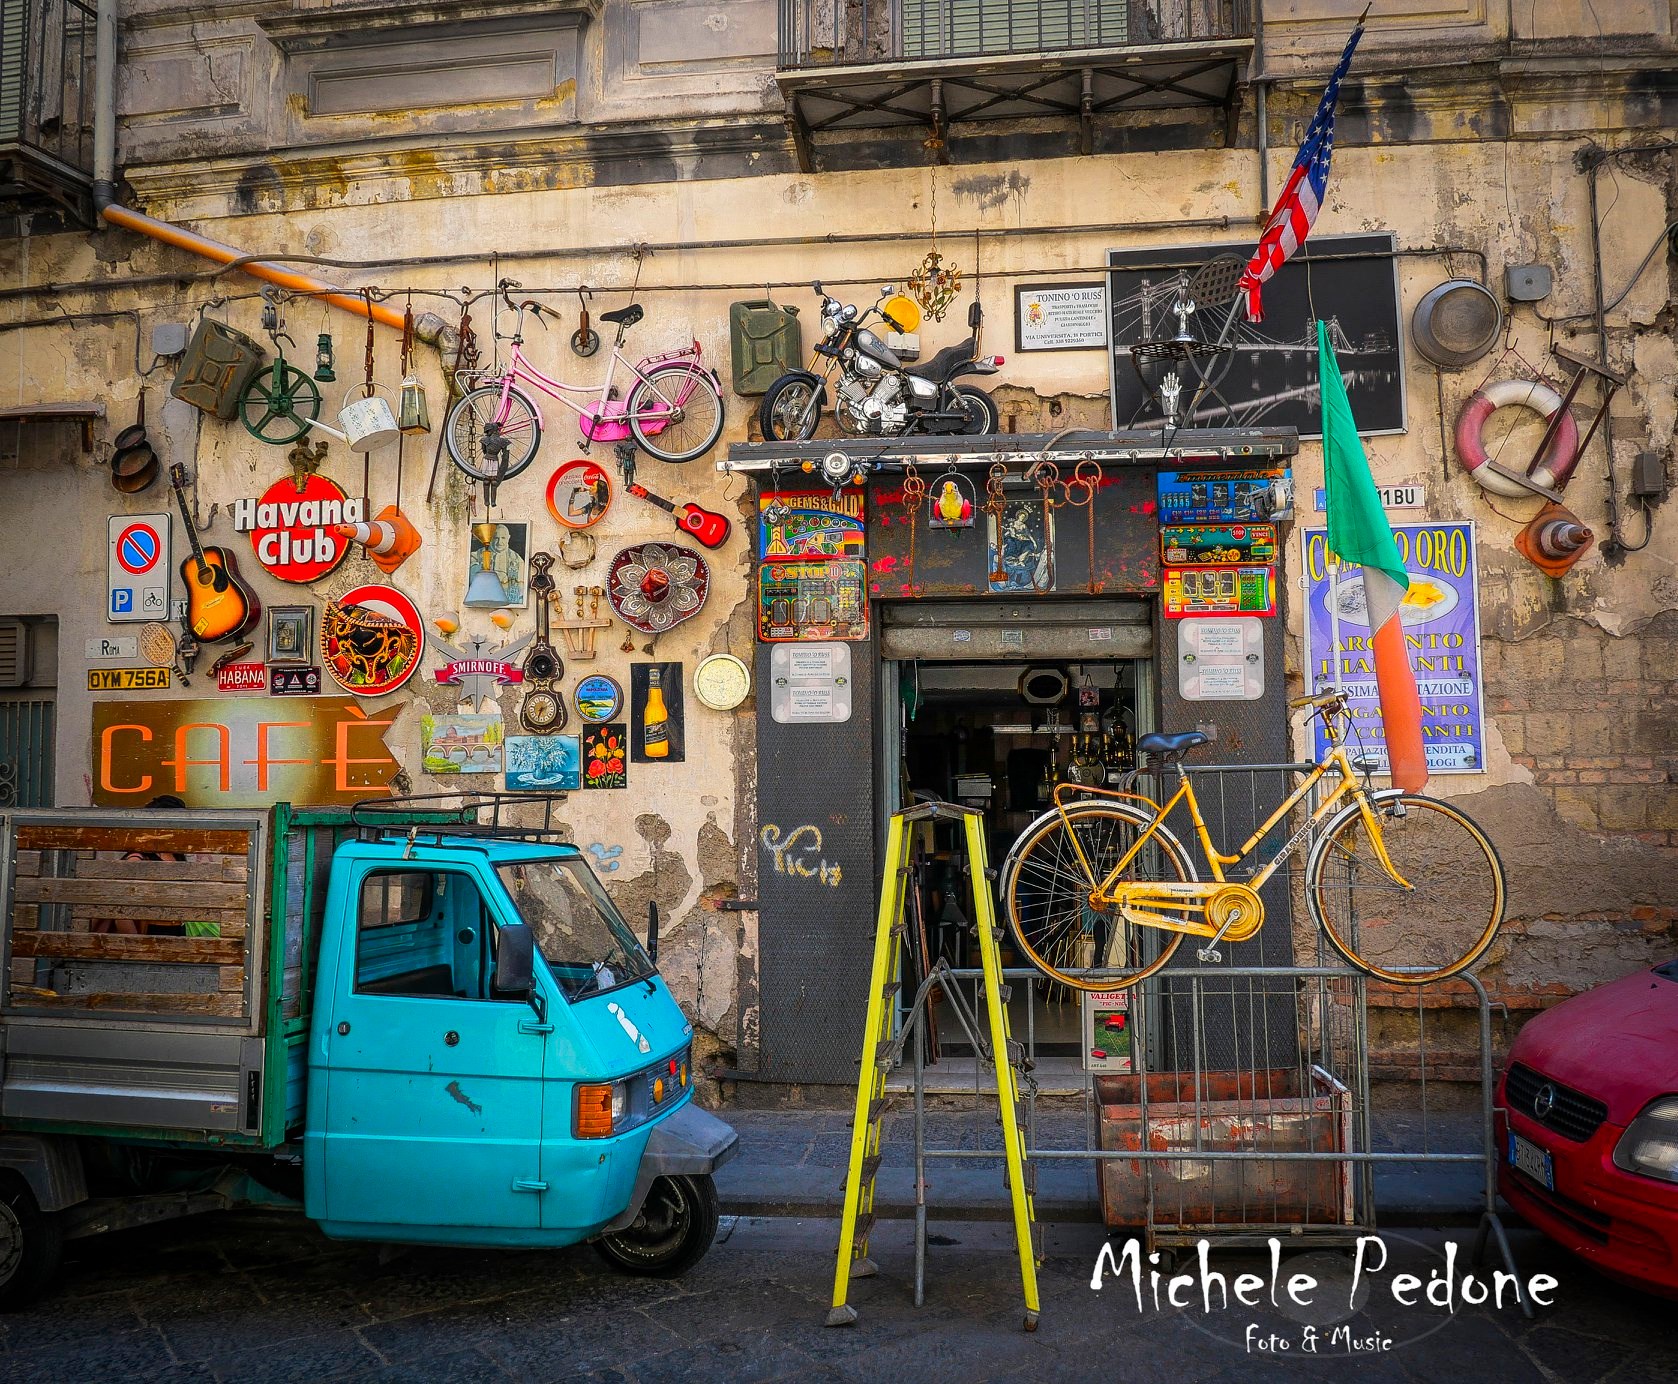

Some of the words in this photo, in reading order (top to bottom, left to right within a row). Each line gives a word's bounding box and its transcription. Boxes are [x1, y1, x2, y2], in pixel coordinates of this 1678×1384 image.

[1036, 292, 1070, 302] TONINO
[1081, 291, 1102, 301] RUSS
[234, 497, 364, 531] Havana
[258, 527, 336, 566] Club
[1415, 527, 1467, 578] ORO
[114, 590, 130, 611] P
[124, 670, 168, 686] 756A
[219, 669, 265, 685] HABANA
[101, 706, 393, 793] CAFÈ
[1273, 818, 1317, 866] GIRARDENGO
